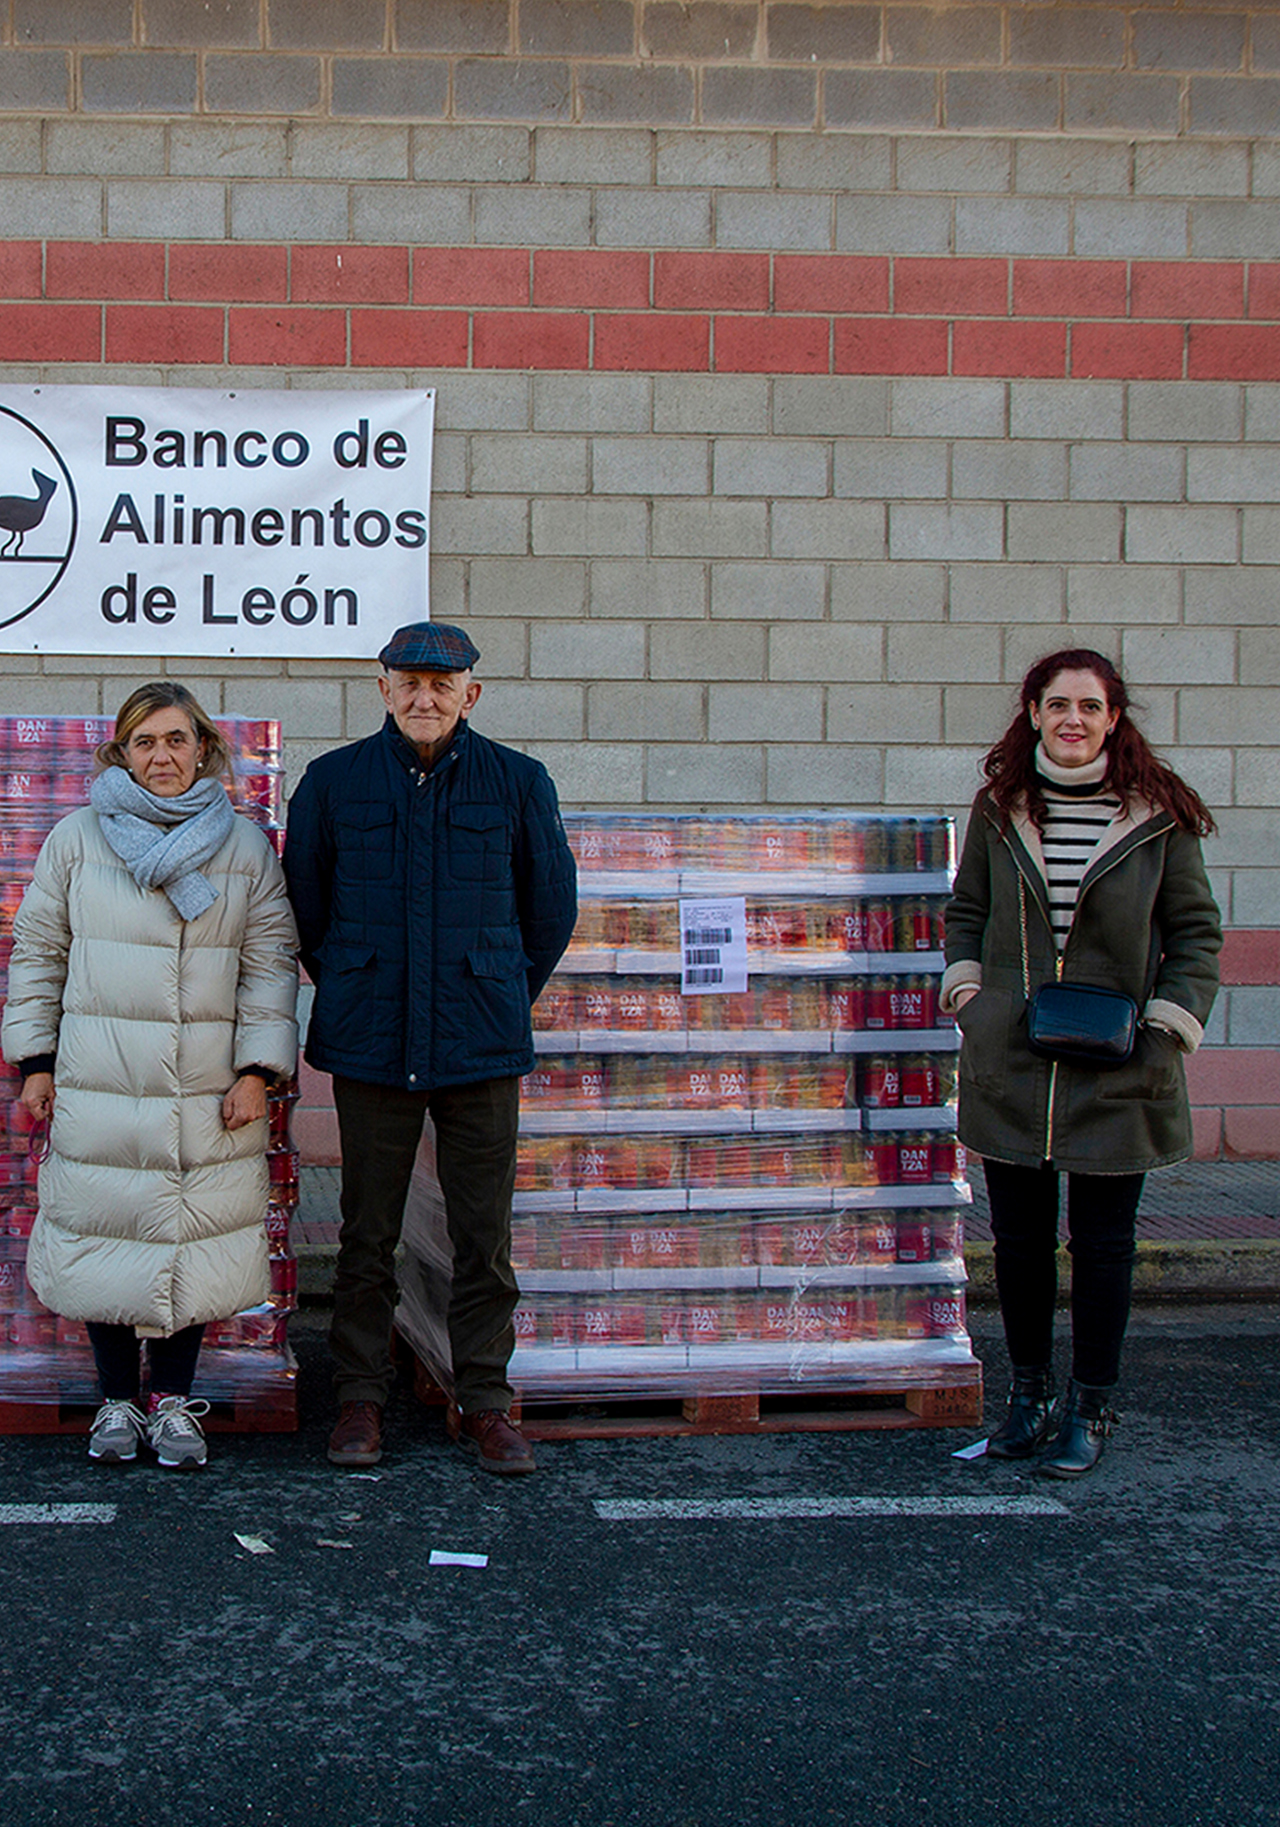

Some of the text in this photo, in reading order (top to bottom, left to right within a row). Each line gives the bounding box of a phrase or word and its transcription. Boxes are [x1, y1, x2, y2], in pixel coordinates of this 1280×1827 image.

[106, 417, 406, 468] Banco de
[100, 494, 425, 548] Alimentos
[102, 573, 357, 625] de León
[17, 721, 46, 731] DAN
[18, 733, 41, 742] TZA
[10, 787, 24, 797] ZA
[645, 837, 671, 846] DAN
[646, 849, 667, 857] TZA
[621, 1007, 642, 1016] TZA
[720, 1074, 746, 1083] DAN
[720, 1085, 741, 1094] TZA
[887, 1084, 898, 1092] TZ
[901, 1150, 928, 1159] DAN
[902, 1161, 923, 1170] TZA
[933, 1302, 960, 1311] DAN
[585, 1312, 610, 1321] DAN
[692, 1310, 719, 1319] DAN
[934, 1314, 954, 1323] TZA
[586, 1323, 606, 1332] TZA
[693, 1322, 713, 1330] TZA
